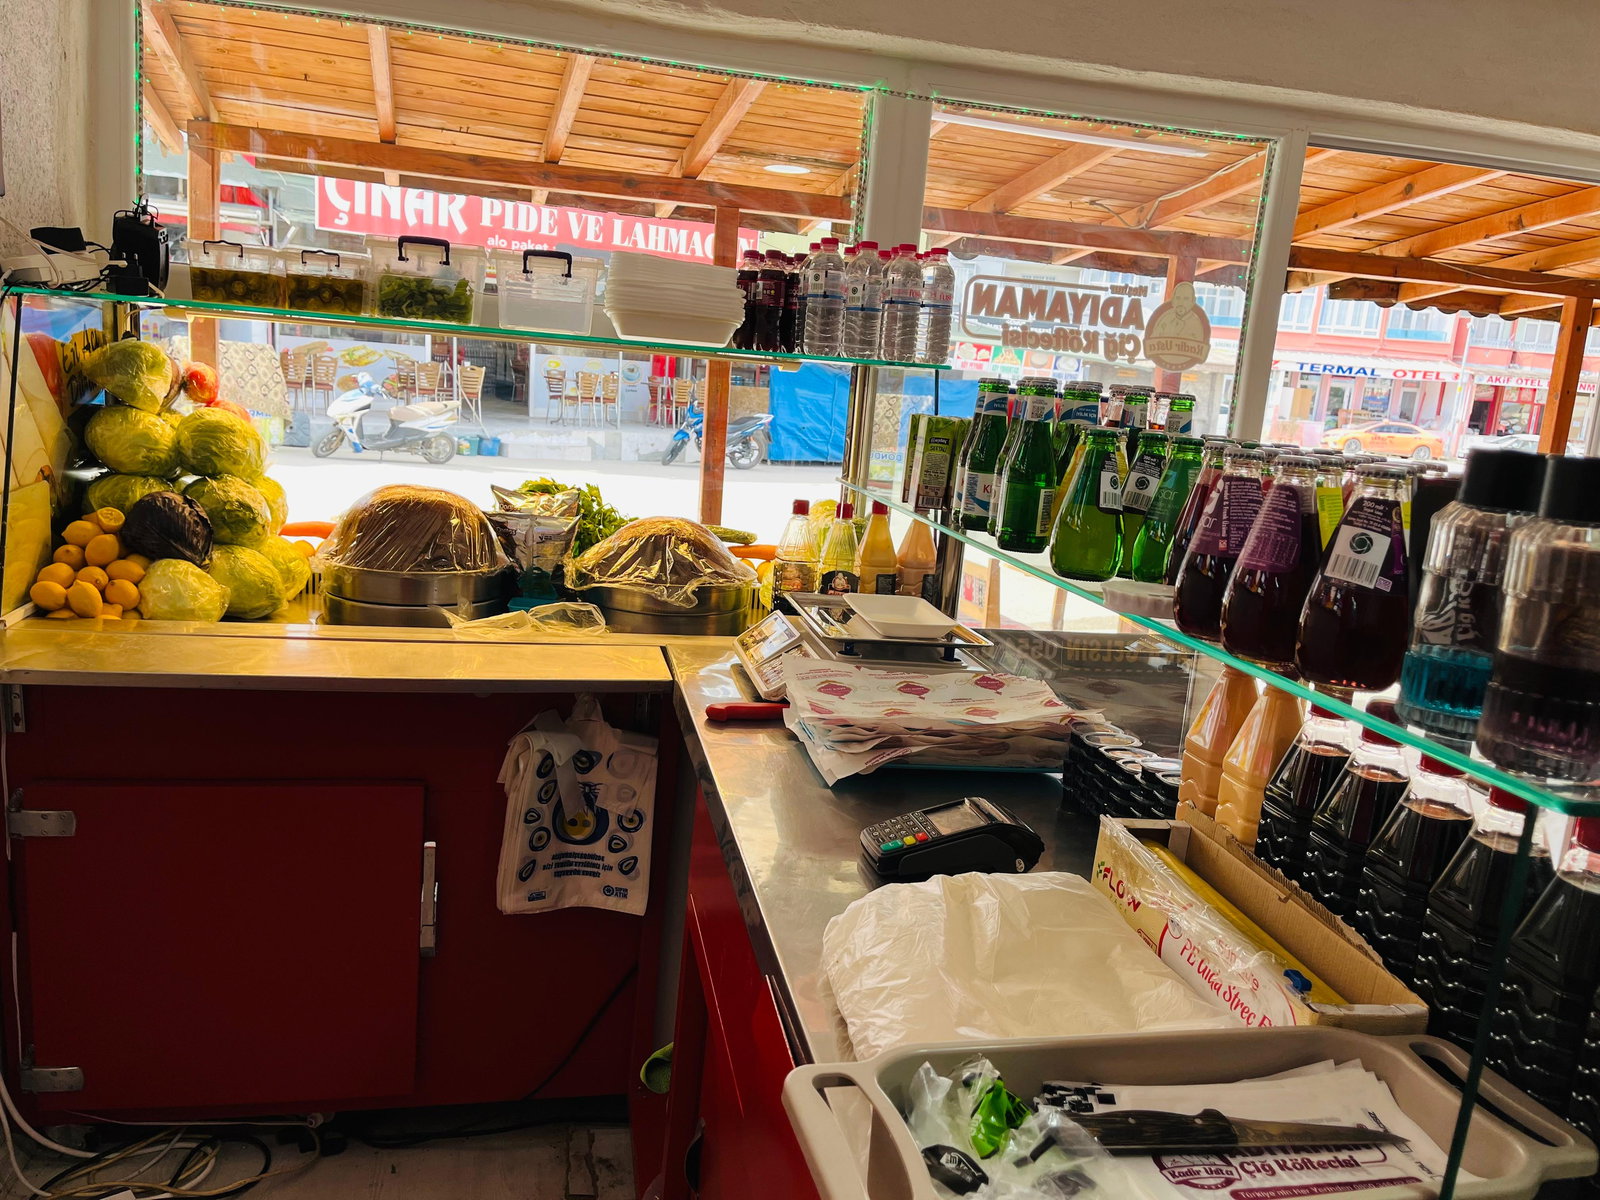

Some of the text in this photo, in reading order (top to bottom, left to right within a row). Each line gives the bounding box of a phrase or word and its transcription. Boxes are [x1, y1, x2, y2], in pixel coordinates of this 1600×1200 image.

[324, 177, 468, 234] ÇINAR
[566, 212, 603, 243] VE
[612, 219, 755, 263] LAHMACN
[487, 235, 507, 247] alo
[1296, 361, 1445, 382] TERMAL OTEL
[1515, 377, 1543, 387] OTEL
[1102, 866, 1142, 912] FLOW
[1179, 938, 1199, 967] PE
[1168, 1165, 1234, 1180] Kadir Usta
[1240, 1155, 1361, 1179] Çiğ Köftecisi
[1293, 1187, 1310, 1196] Her
[1310, 1184, 1353, 1194] Yerinden
